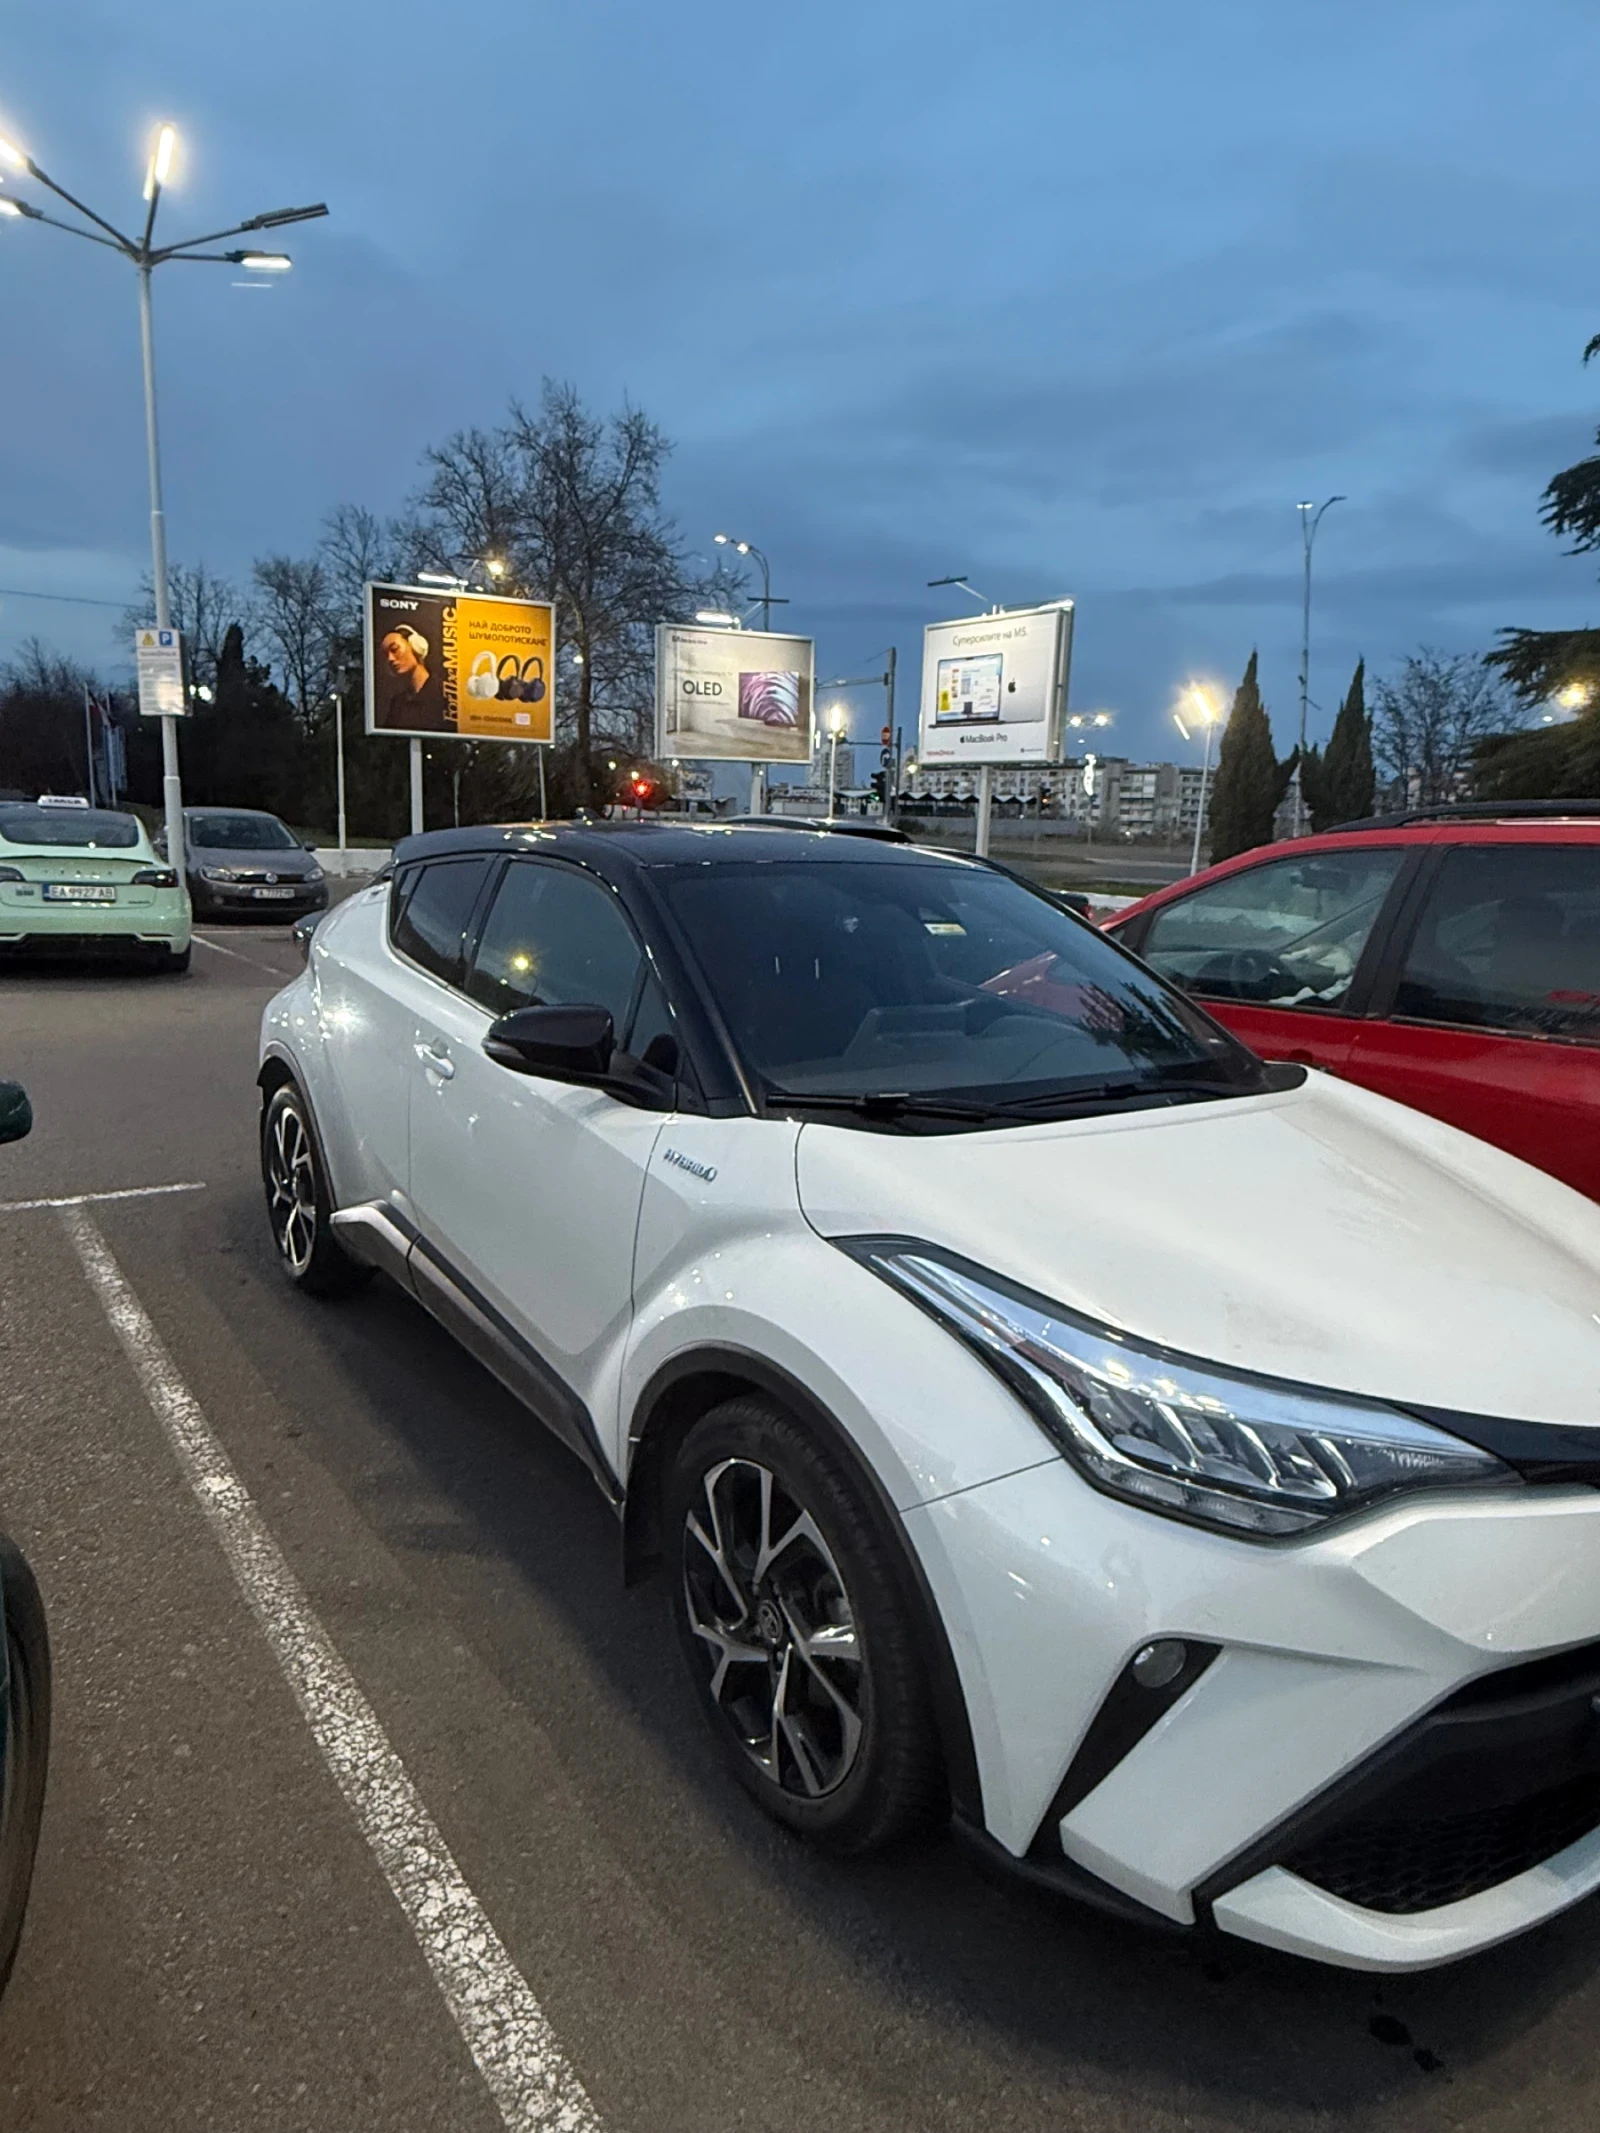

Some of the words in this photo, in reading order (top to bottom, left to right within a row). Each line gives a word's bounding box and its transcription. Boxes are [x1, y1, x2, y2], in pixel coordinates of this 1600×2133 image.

[380, 599, 419, 611] SONY
[468, 620, 488, 629] НАЙ
[490, 622, 532, 635] ДОБРОТО
[162, 632, 170, 645] P
[952, 632, 1001, 647] Суперсилите
[1003, 631, 1012, 640] на
[682, 679, 723, 697] OLED
[965, 733, 995, 744] MacBook
[996, 732, 1008, 743] Pro
[51, 886, 67, 898] EA
